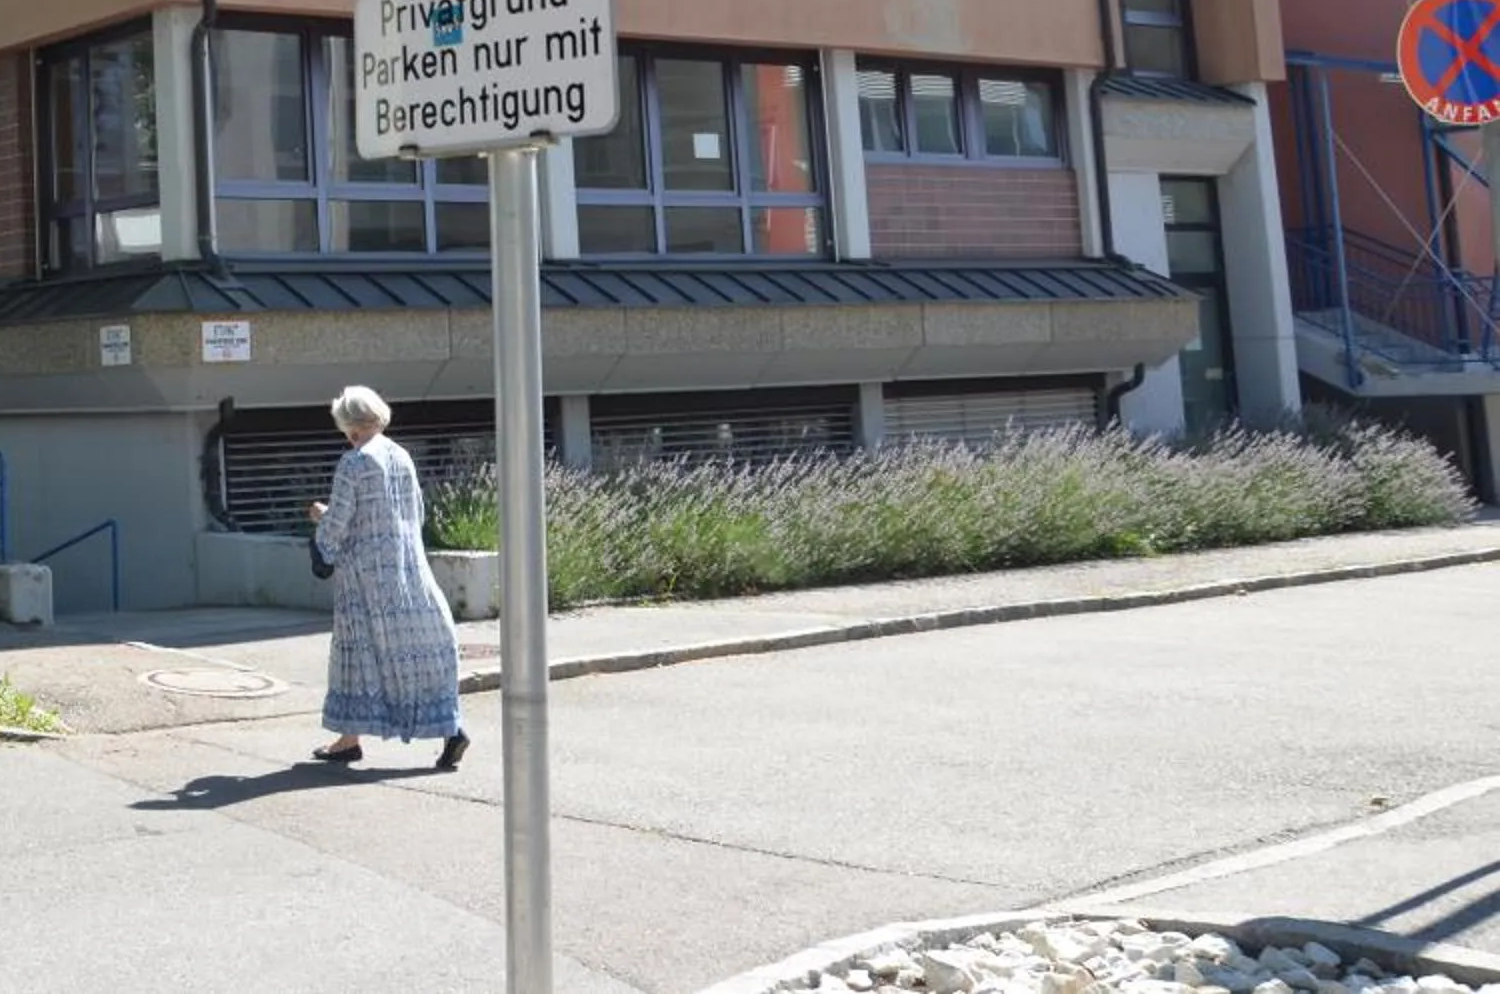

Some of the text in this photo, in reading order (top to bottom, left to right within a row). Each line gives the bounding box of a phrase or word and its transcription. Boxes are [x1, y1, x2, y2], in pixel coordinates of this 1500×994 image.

[363, 16, 602, 89] Parken nur mit
[377, 82, 585, 136] Berechtigung
